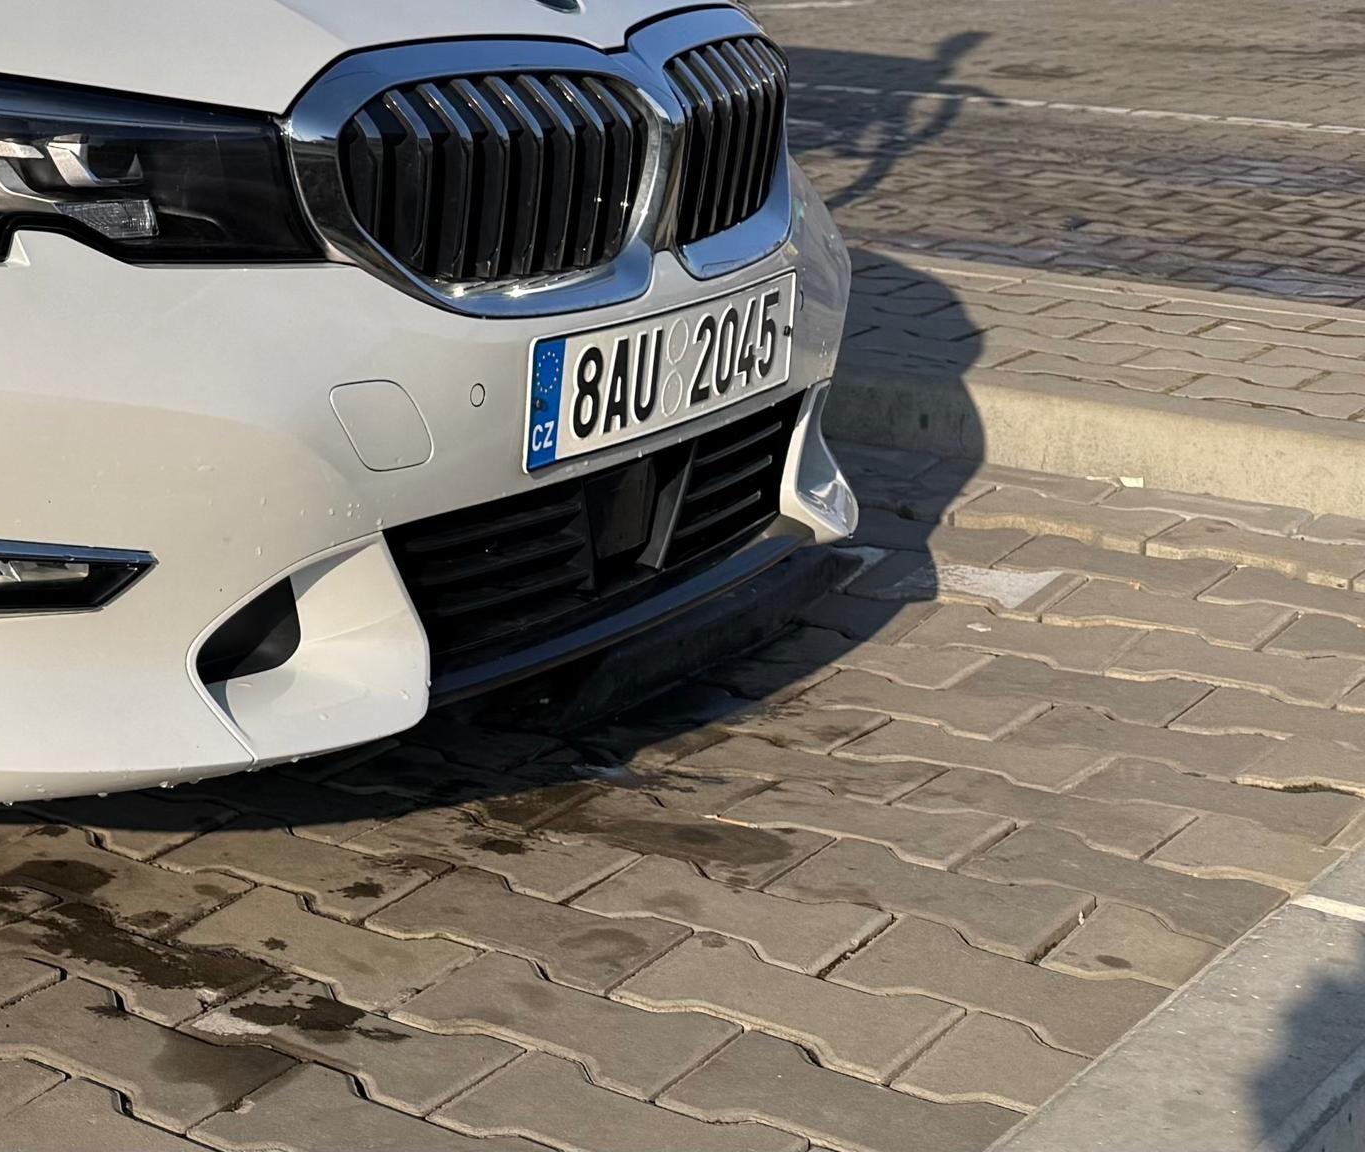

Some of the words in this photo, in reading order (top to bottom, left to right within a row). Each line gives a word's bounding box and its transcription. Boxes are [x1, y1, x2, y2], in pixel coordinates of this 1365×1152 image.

[570, 327, 663, 439] 8AU
[685, 288, 780, 408] 2045
[532, 420, 555, 452] CZ
